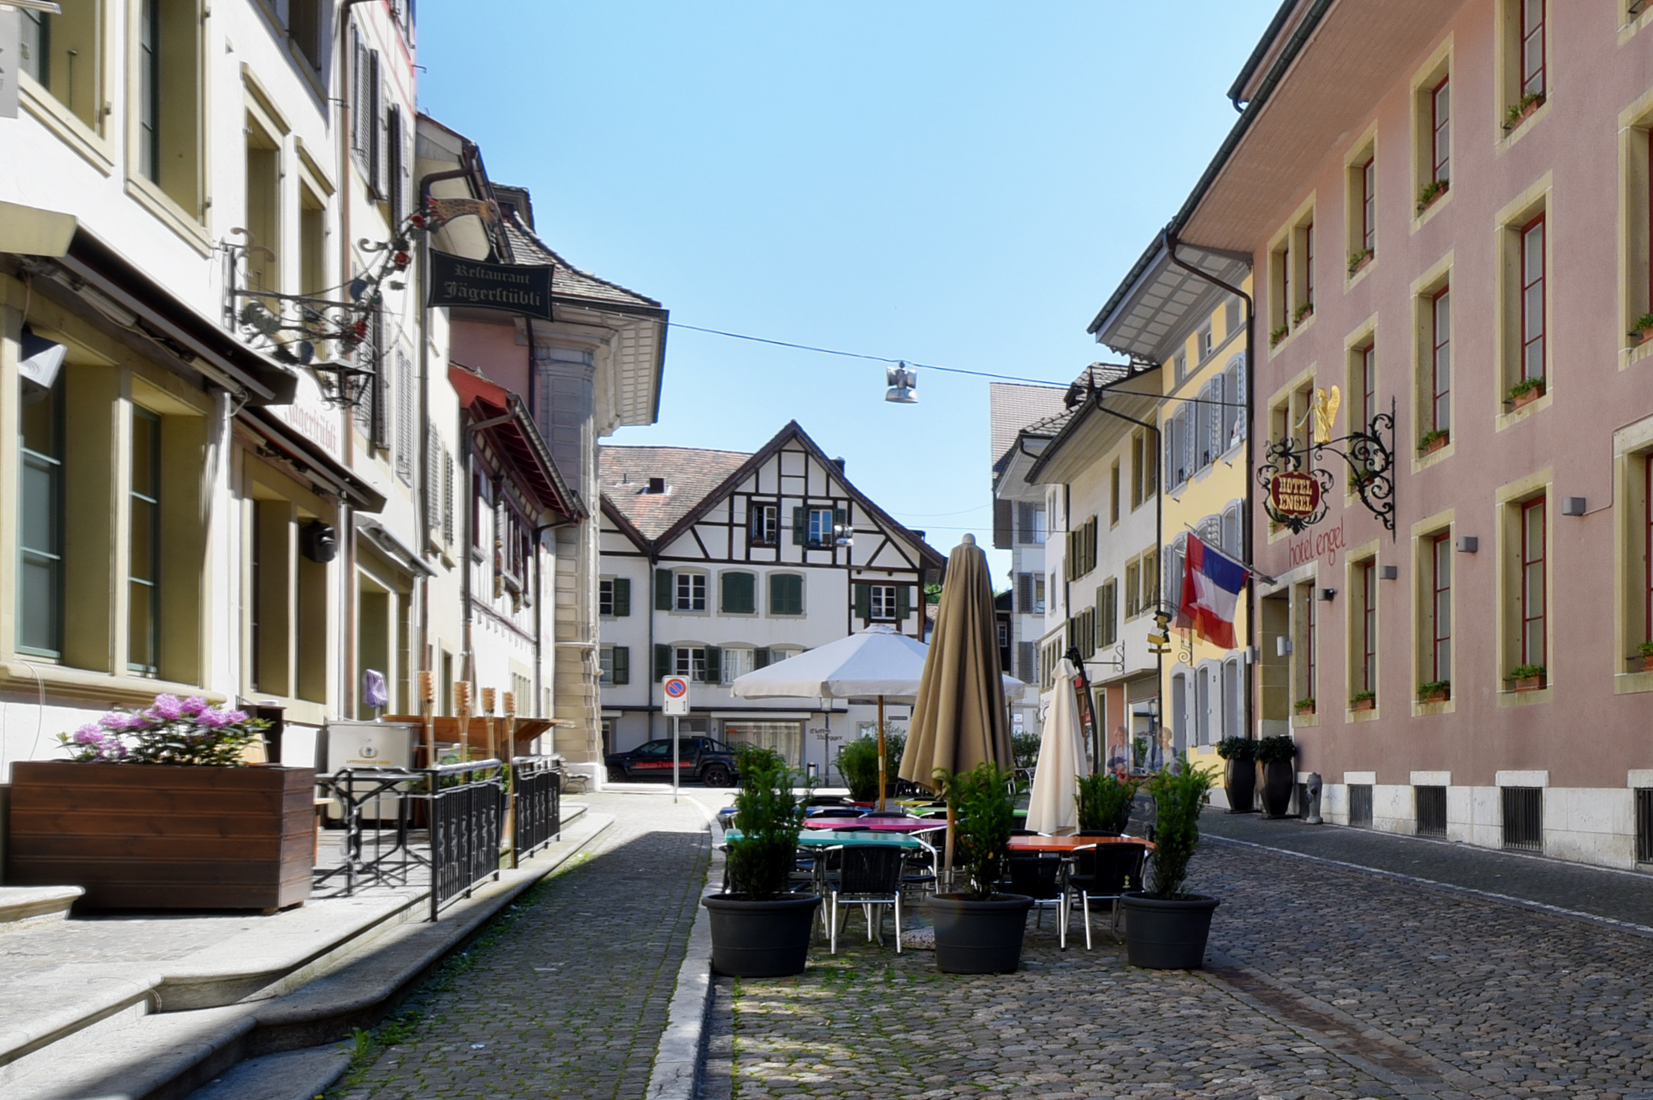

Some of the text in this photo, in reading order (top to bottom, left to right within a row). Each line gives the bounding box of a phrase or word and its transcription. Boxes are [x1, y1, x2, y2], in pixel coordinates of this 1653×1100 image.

[455, 264, 529, 284] Restaurant
[1279, 477, 1312, 495] HOTEL
[1279, 494, 1312, 511] ENGEL
[1288, 515, 1346, 567] hotel engel
